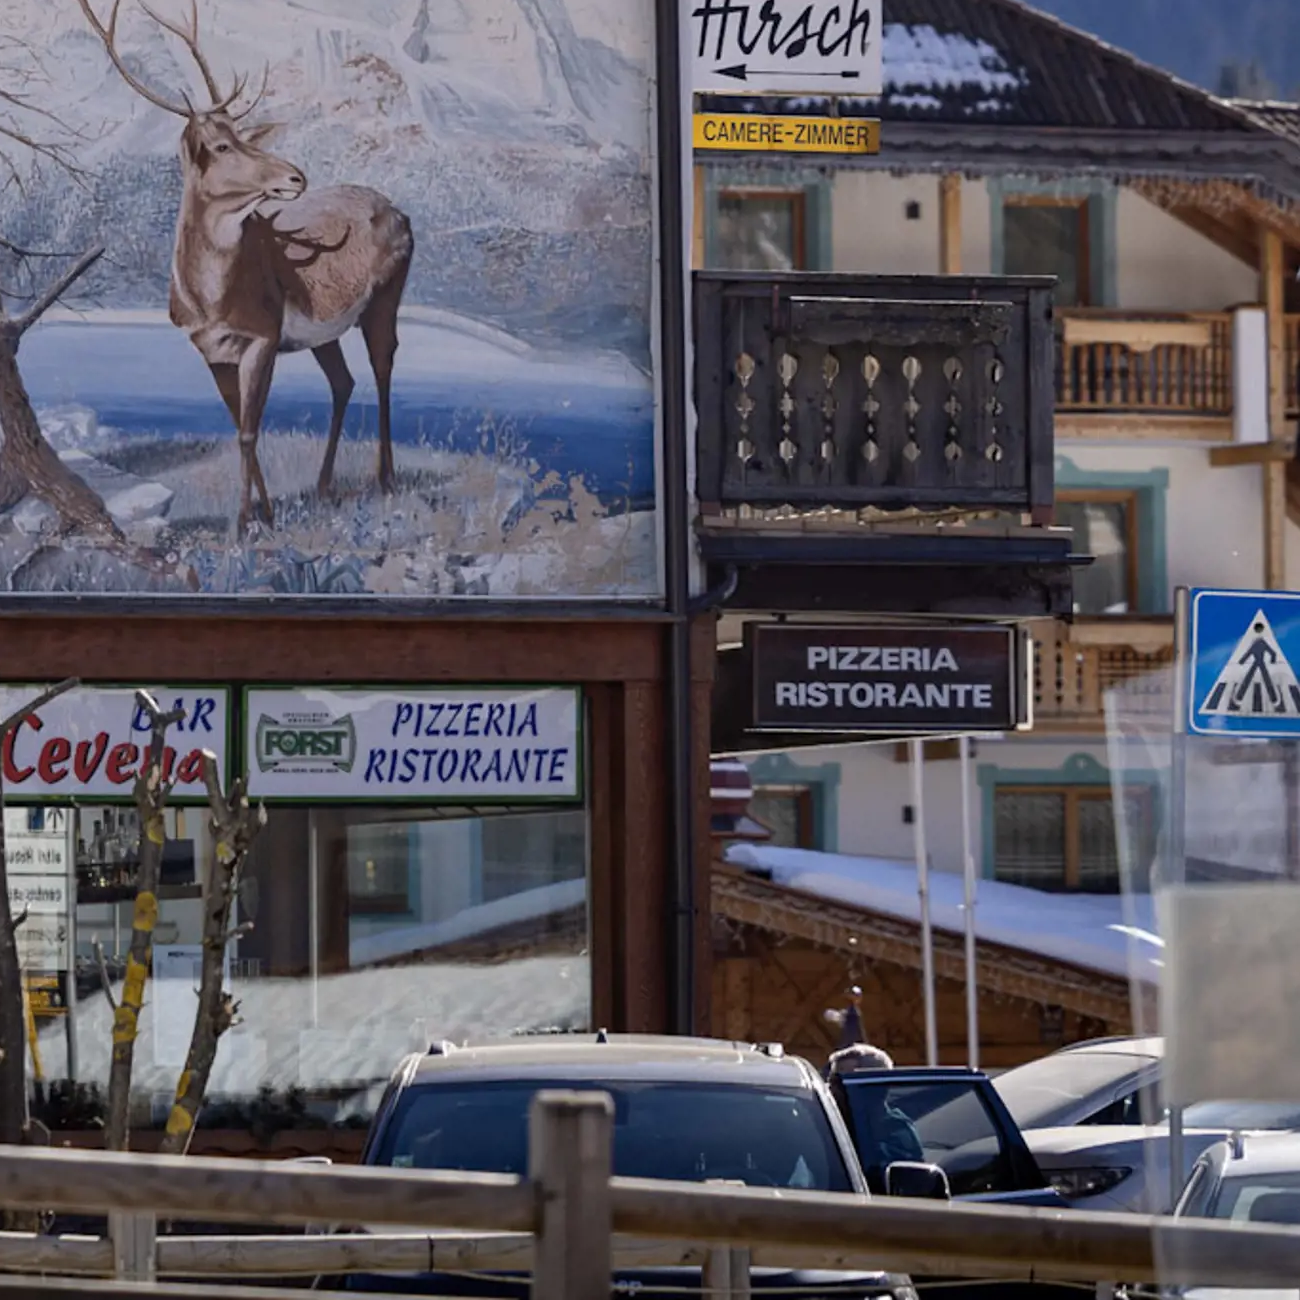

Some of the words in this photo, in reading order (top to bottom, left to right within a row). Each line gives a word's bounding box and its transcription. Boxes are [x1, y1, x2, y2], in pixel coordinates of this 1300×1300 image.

[703, 120, 870, 145] CAMERE-ZIMMER
[807, 646, 959, 671] PIZZERIA
[775, 682, 992, 708] RISTORANTE
[392, 702, 538, 738] PIZZERIA
[264, 730, 348, 756] FORST
[364, 748, 568, 783] RISTORANTE
